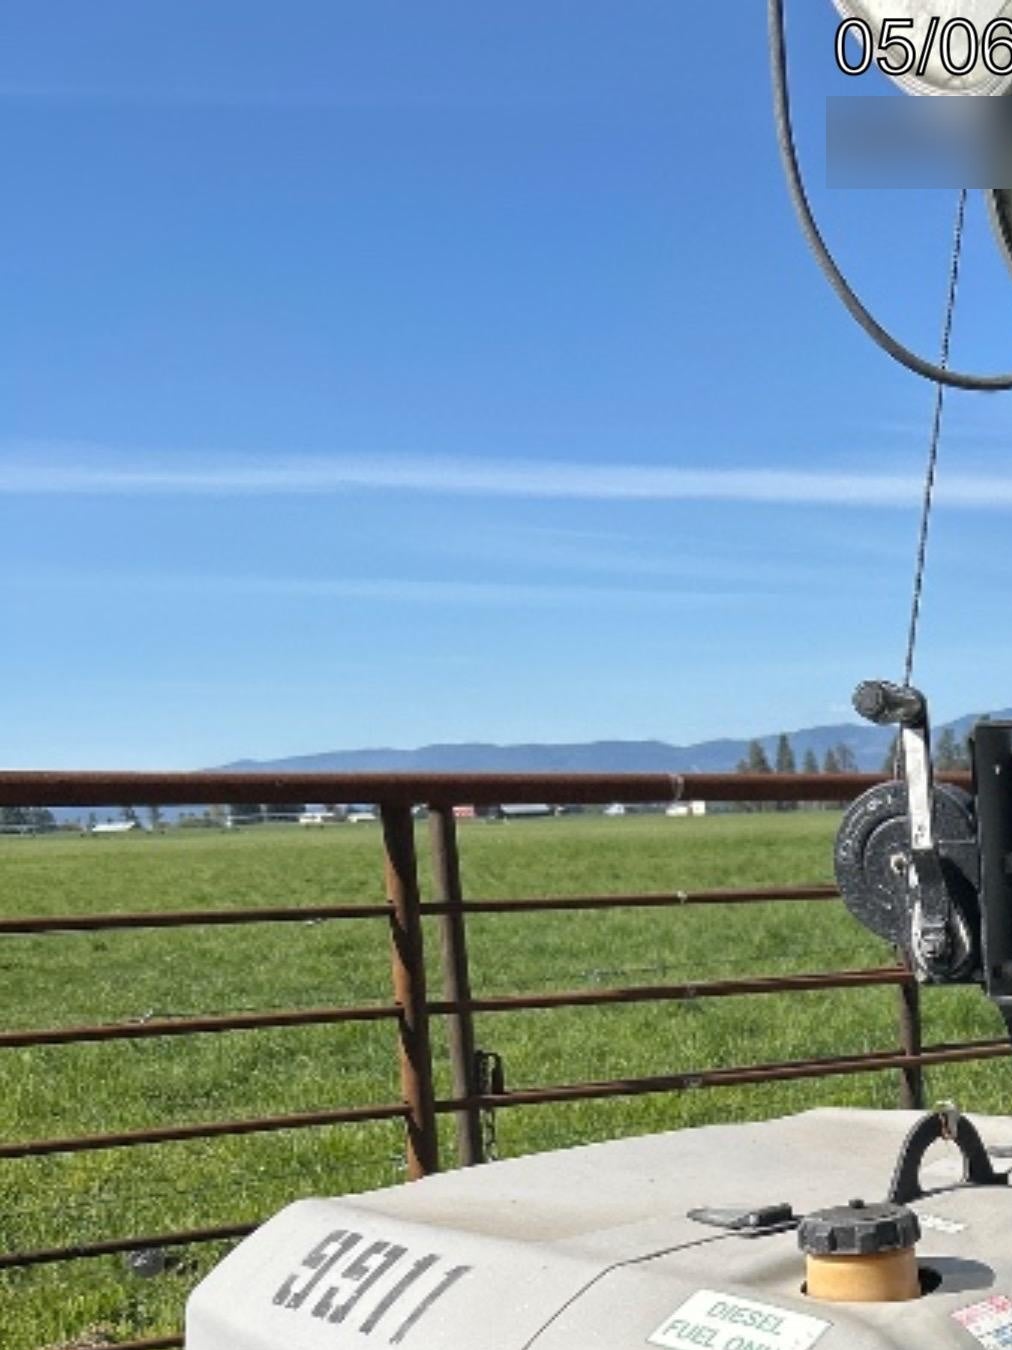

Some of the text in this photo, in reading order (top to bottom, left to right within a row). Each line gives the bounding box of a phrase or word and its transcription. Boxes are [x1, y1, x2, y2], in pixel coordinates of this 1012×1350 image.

[271, 1229, 474, 1345] 9911
[662, 1318, 721, 1348] FUEL
[706, 1300, 787, 1336] DIESEL
